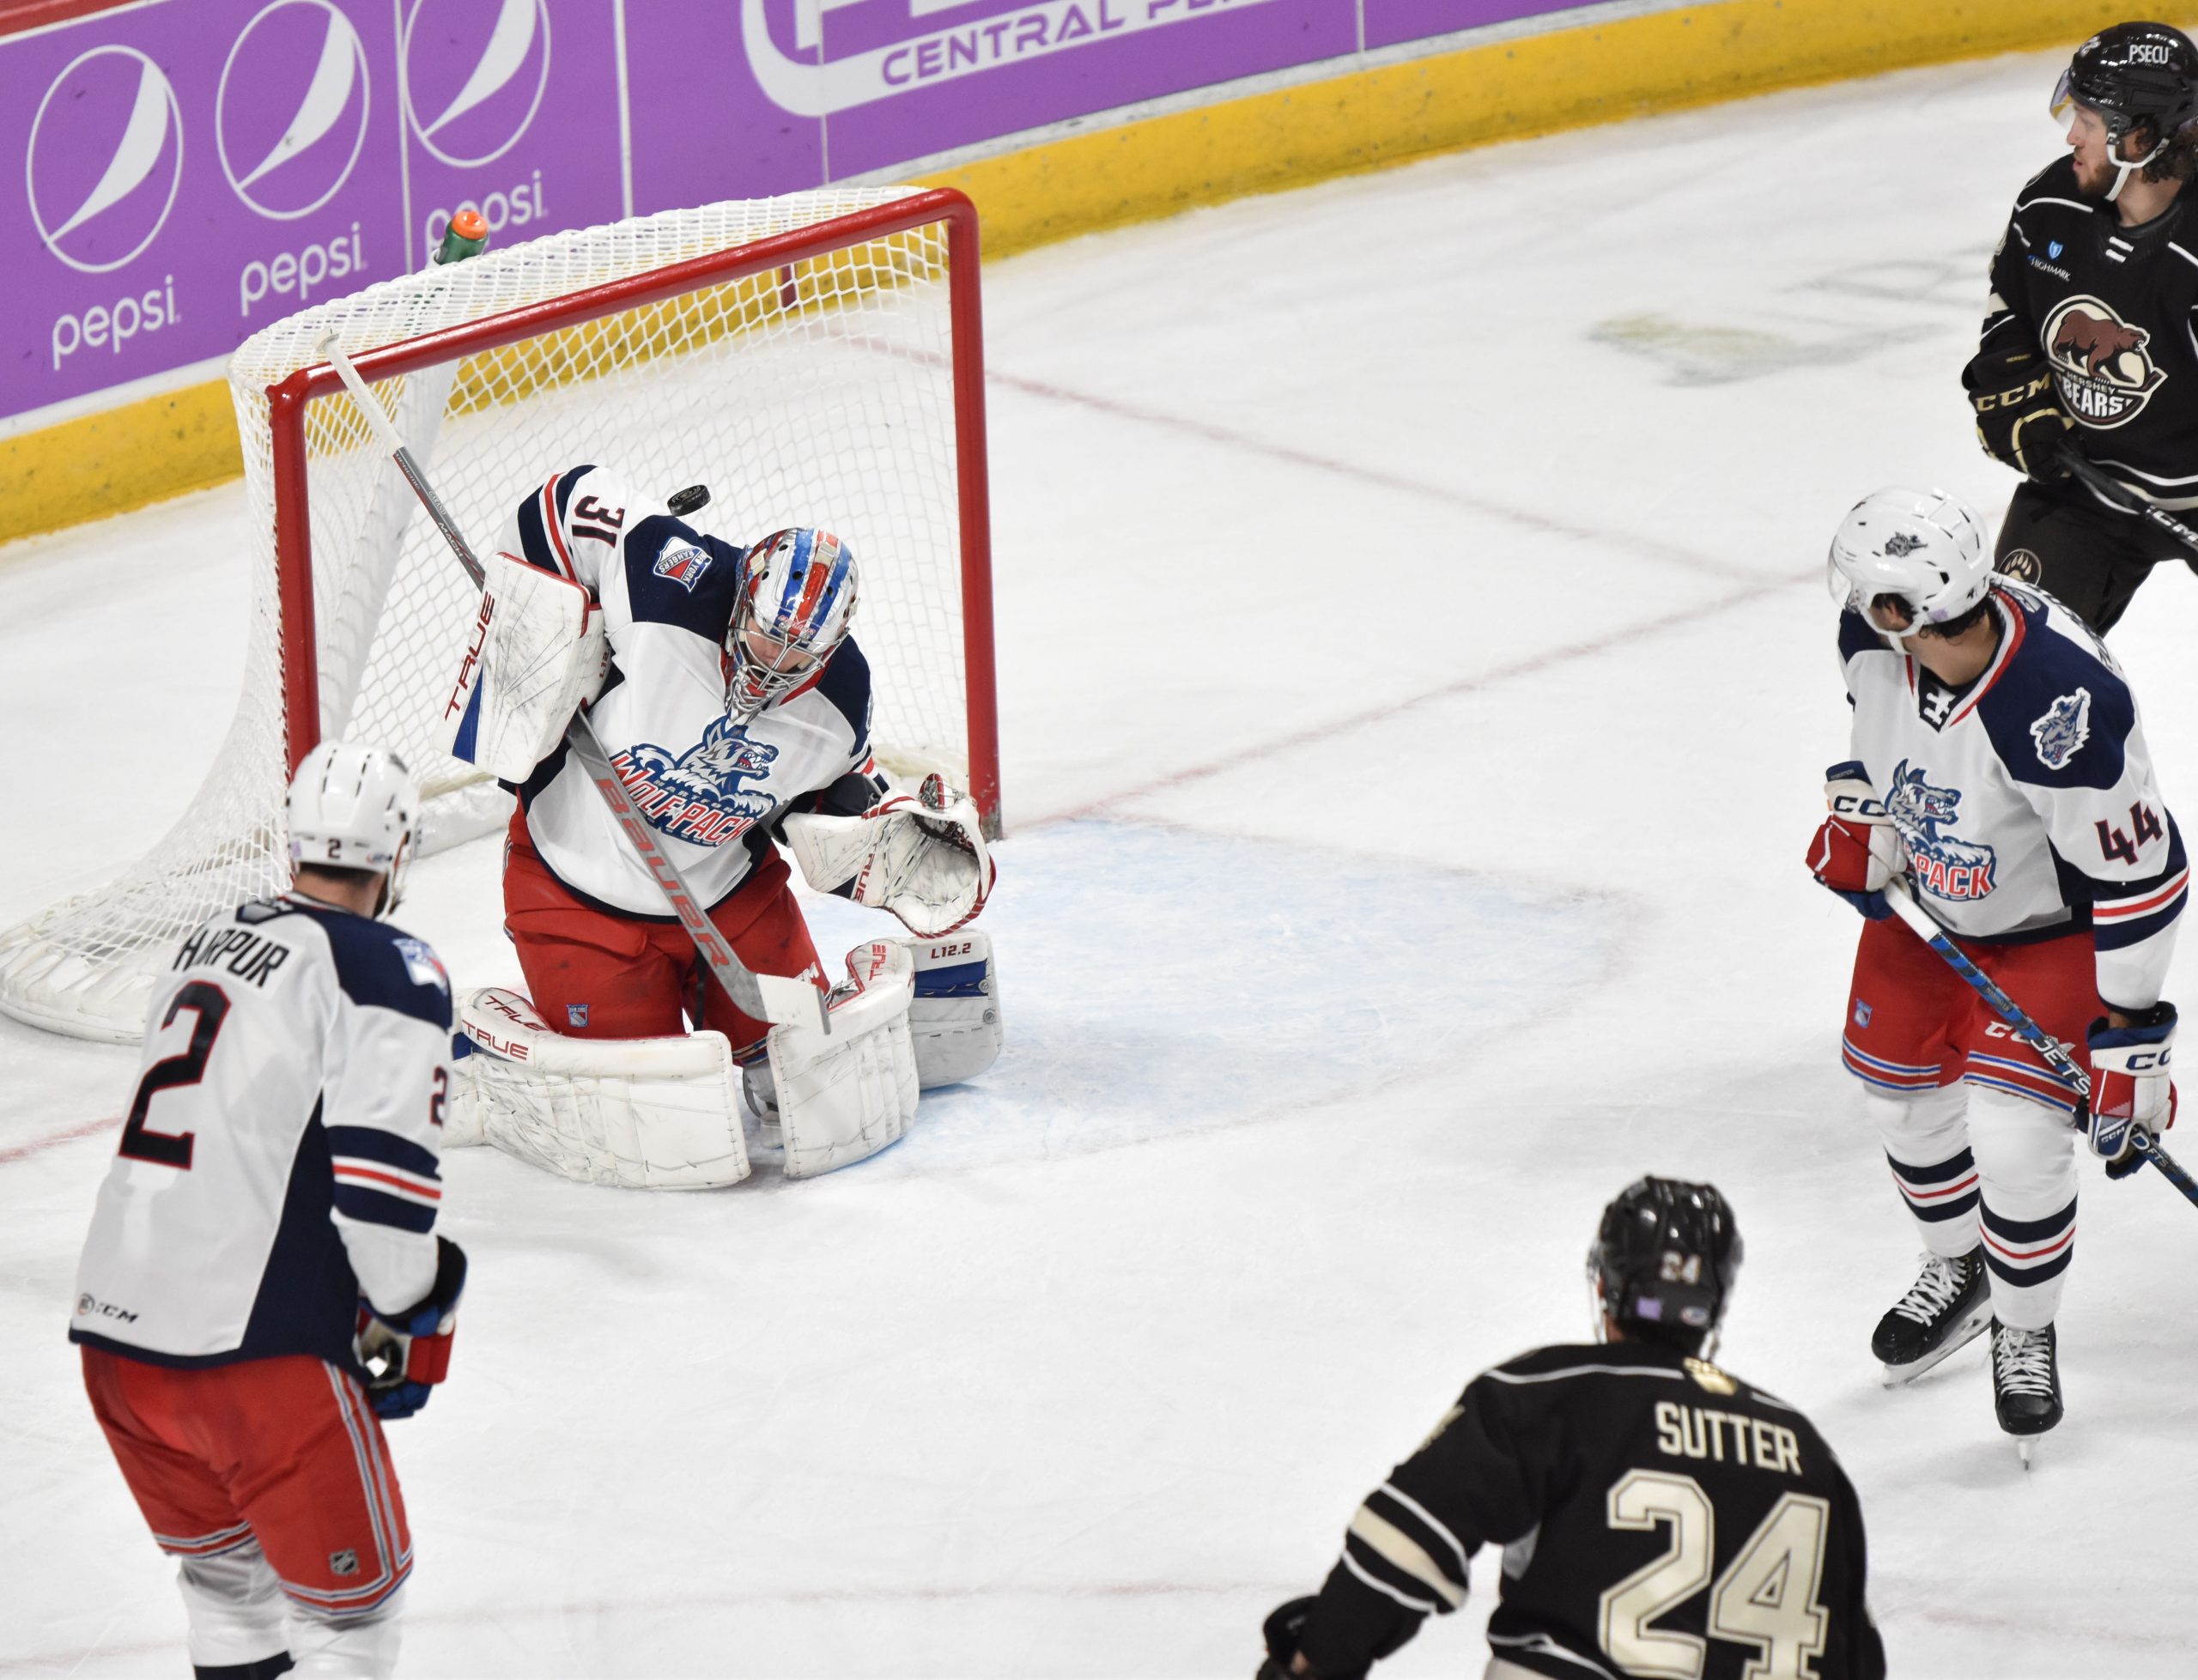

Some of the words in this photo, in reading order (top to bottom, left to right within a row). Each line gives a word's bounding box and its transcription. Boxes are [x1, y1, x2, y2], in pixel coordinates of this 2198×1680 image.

[882, 0, 1126, 85] CENTRAL
[2128, 44, 2170, 65] PSECU
[240, 223, 363, 316] pepsi
[2031, 258, 2071, 282] HIGHMARK
[52, 276, 177, 371] pepsi
[1976, 372, 2051, 412] CCM
[2066, 372, 2116, 396] HERSHEY
[438, 522, 464, 557] MACH
[571, 494, 626, 549] 31
[658, 549, 695, 574] RANGERS
[682, 562, 700, 585] YORK
[444, 591, 495, 721] TRUE
[610, 752, 687, 821] WOLF
[665, 802, 759, 847] PACK
[1833, 795, 1888, 817] CC
[327, 838, 342, 859] 2
[2093, 800, 2166, 866] 44
[595, 778, 730, 967] BAUER
[1915, 853, 1993, 899] PACK
[869, 943, 887, 981] TRUE
[931, 942, 972, 960] L12.2
[462, 1019, 529, 1061] TRUE
[118, 979, 232, 1172] 2
[430, 1064, 449, 1126] 2
[2101, 1126, 2126, 1143] CCM
[1655, 1401, 1803, 1477] SUTTER
[1598, 1467, 1831, 1680] 24
